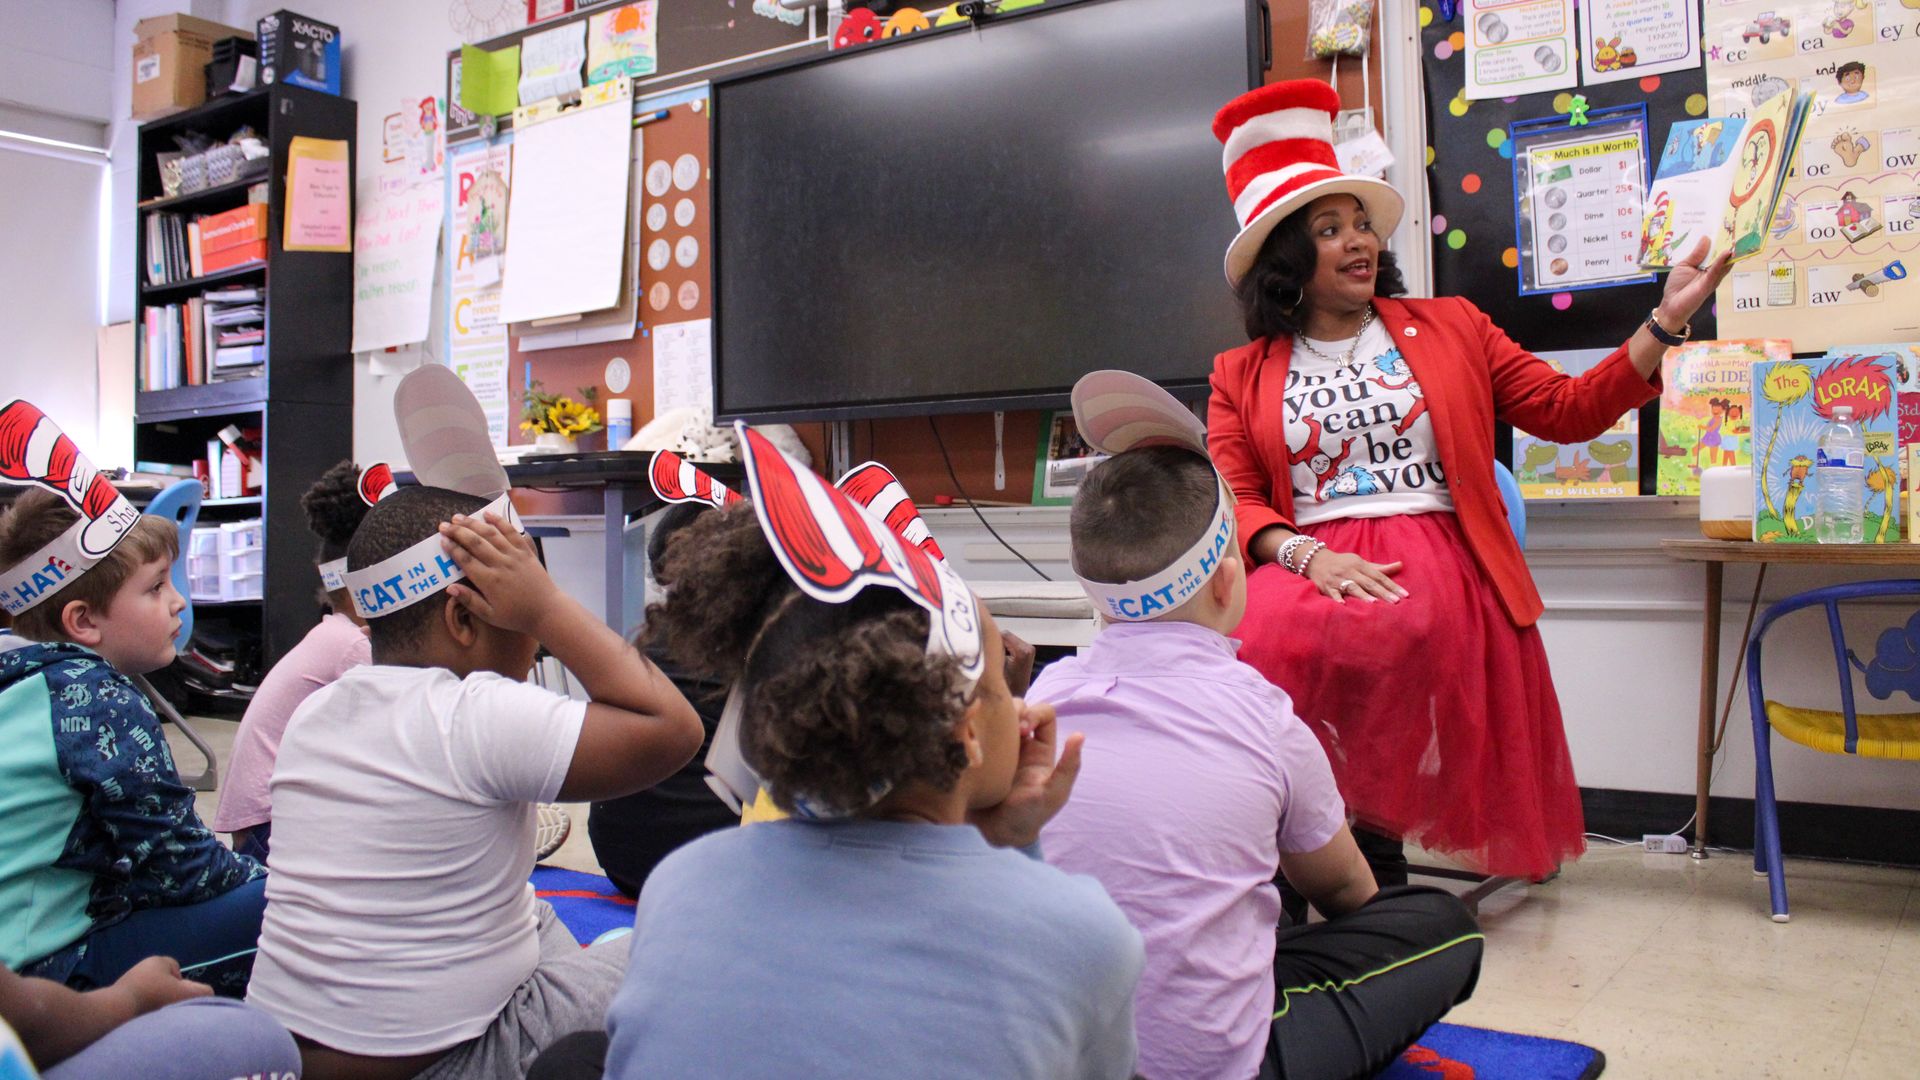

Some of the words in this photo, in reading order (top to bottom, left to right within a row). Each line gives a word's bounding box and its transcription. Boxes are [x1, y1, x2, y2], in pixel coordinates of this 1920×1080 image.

[1626, 16, 1653, 26] quarter
[1881, 24, 1903, 42] ey
[1801, 36, 1825, 50] ea
[1726, 48, 1748, 63] ee
[1816, 62, 1836, 76] end
[1731, 73, 1768, 90] middle
[1555, 149, 1580, 159] Much
[1602, 139, 1638, 152] Worth?
[1885, 153, 1918, 168] ow
[1579, 165, 1602, 175] Dollar
[1807, 162, 1831, 177] oe
[1576, 188, 1608, 199] Quarter
[1615, 184, 1633, 194] 25¢
[1584, 212, 1604, 221] Dime
[1617, 207, 1633, 217] 10¢
[1810, 226, 1836, 240] oo
[1888, 218, 1915, 233] ue
[1583, 234, 1608, 244] Nickel
[1620, 230, 1633, 240] 5¢
[1585, 258, 1610, 268] Penny
[1624, 254, 1633, 263] 1¢
[1736, 294, 1761, 309] au
[1812, 290, 1841, 304] aw
[454, 297, 472, 335] C
[1690, 370, 1716, 383] BIG
[1722, 370, 1749, 383] IDE
[1774, 374, 1800, 390] The
[1818, 375, 1887, 405] LORAX
[1284, 381, 1373, 424] you
[1323, 402, 1401, 434] can
[1363, 432, 1412, 464] be
[1865, 441, 1890, 453] LORAX
[1545, 488, 1563, 496] MO
[1567, 486, 1624, 496] WILLEMS
[1199, 520, 1229, 576] HAT
[407, 562, 426, 579] IN
[1178, 568, 1193, 585] IN
[13, 561, 65, 604] HAT
[409, 574, 440, 595] THE
[1178, 575, 1202, 597] THE
[360, 574, 407, 612] CAT
[1118, 583, 1175, 618] CAT
[6, 599, 24, 612] THE
[60, 715, 91, 733] RUN
[128, 724, 155, 752] RUN
